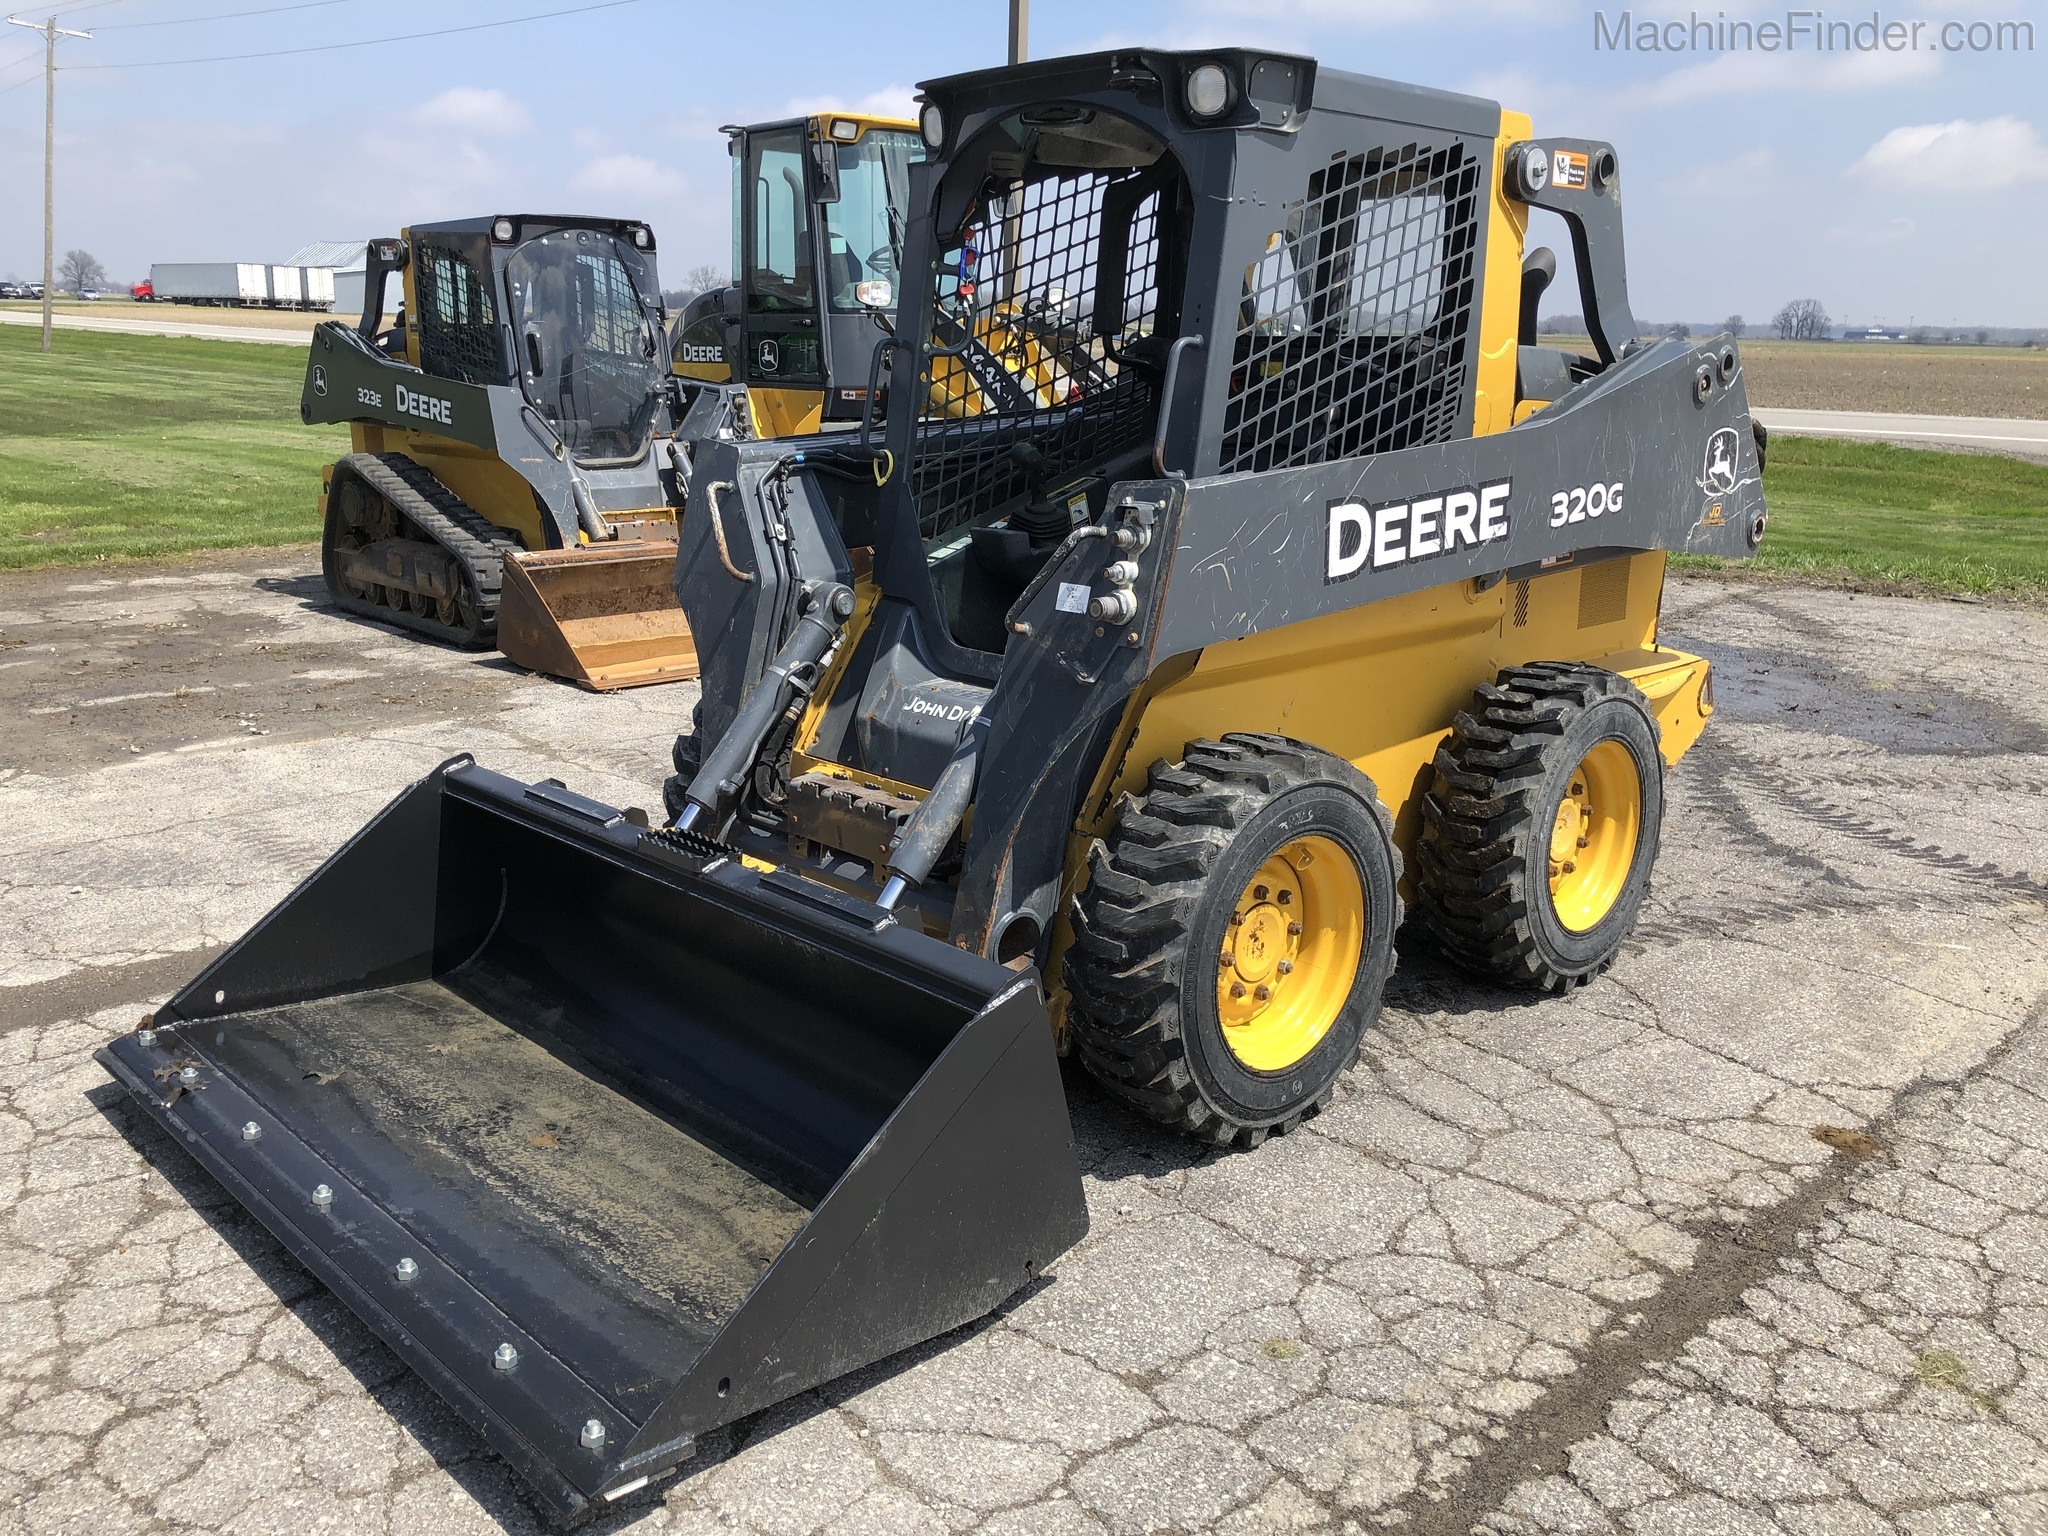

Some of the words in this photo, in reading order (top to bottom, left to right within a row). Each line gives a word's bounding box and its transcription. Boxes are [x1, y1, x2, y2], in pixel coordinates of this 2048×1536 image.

[868, 133, 908, 148] JOHN
[683, 342, 723, 362] DEERE
[357, 387, 382, 408] 323E
[396, 384, 452, 425] DEERE
[1550, 482, 1624, 528] 320G
[1328, 483, 1510, 577] DEERE
[903, 695, 948, 719] JOHN
